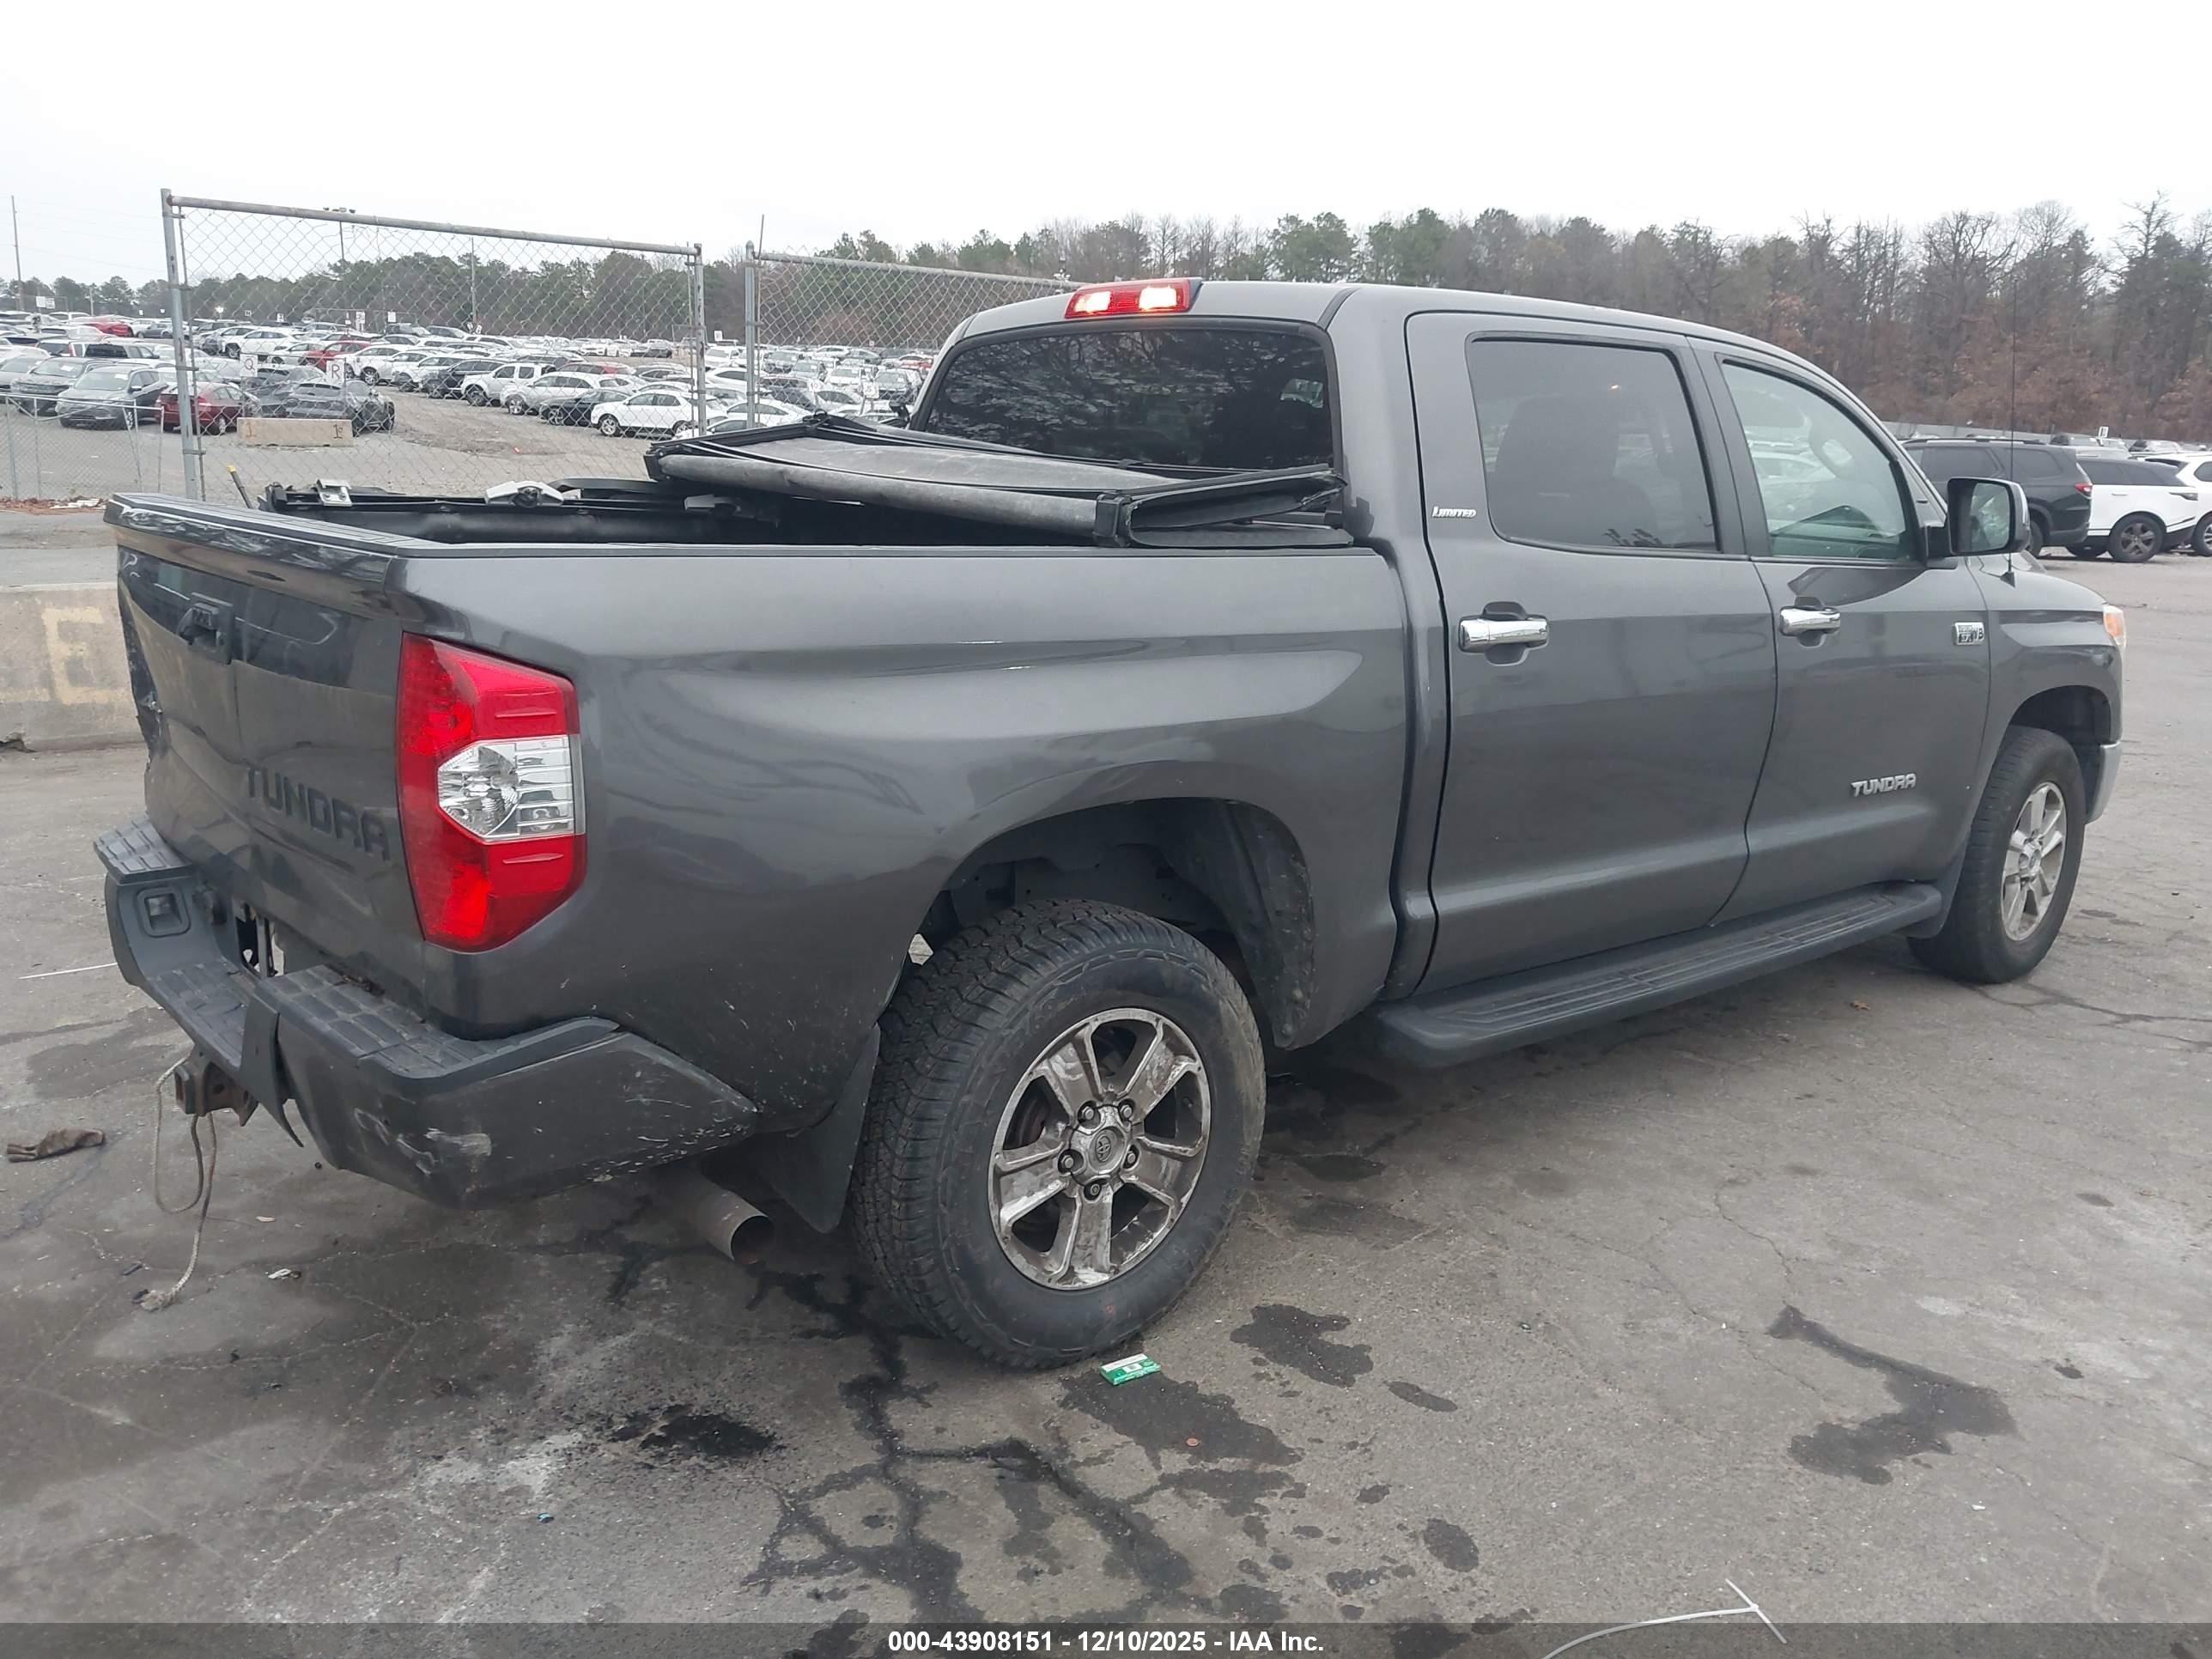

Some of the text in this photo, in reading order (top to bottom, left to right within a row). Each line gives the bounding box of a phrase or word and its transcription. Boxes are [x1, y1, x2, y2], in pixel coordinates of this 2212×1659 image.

[244, 358, 255, 371] Q
[331, 364, 342, 380] R
[1851, 772, 1917, 797] TUNDRA
[245, 766, 392, 862] TUNDRA
